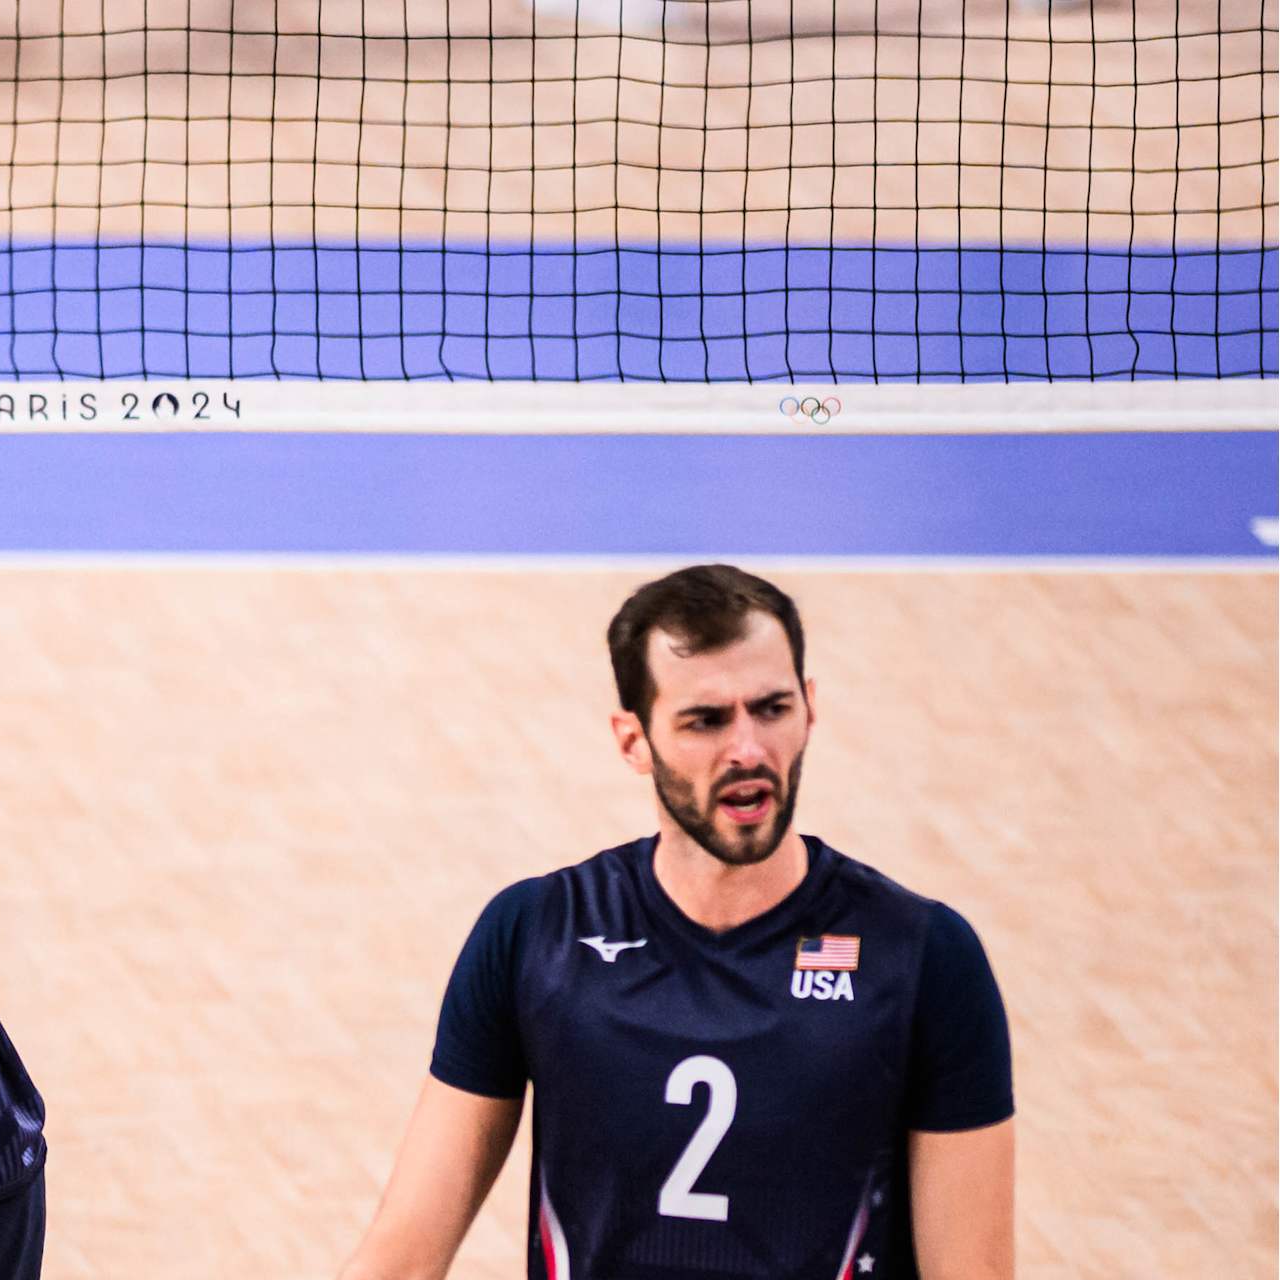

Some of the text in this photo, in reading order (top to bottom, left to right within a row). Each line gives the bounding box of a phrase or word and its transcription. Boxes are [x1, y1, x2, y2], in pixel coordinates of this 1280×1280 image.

[120, 392, 243, 420] 2024
[790, 969, 855, 1002] USA
[657, 1054, 739, 1223] 2
